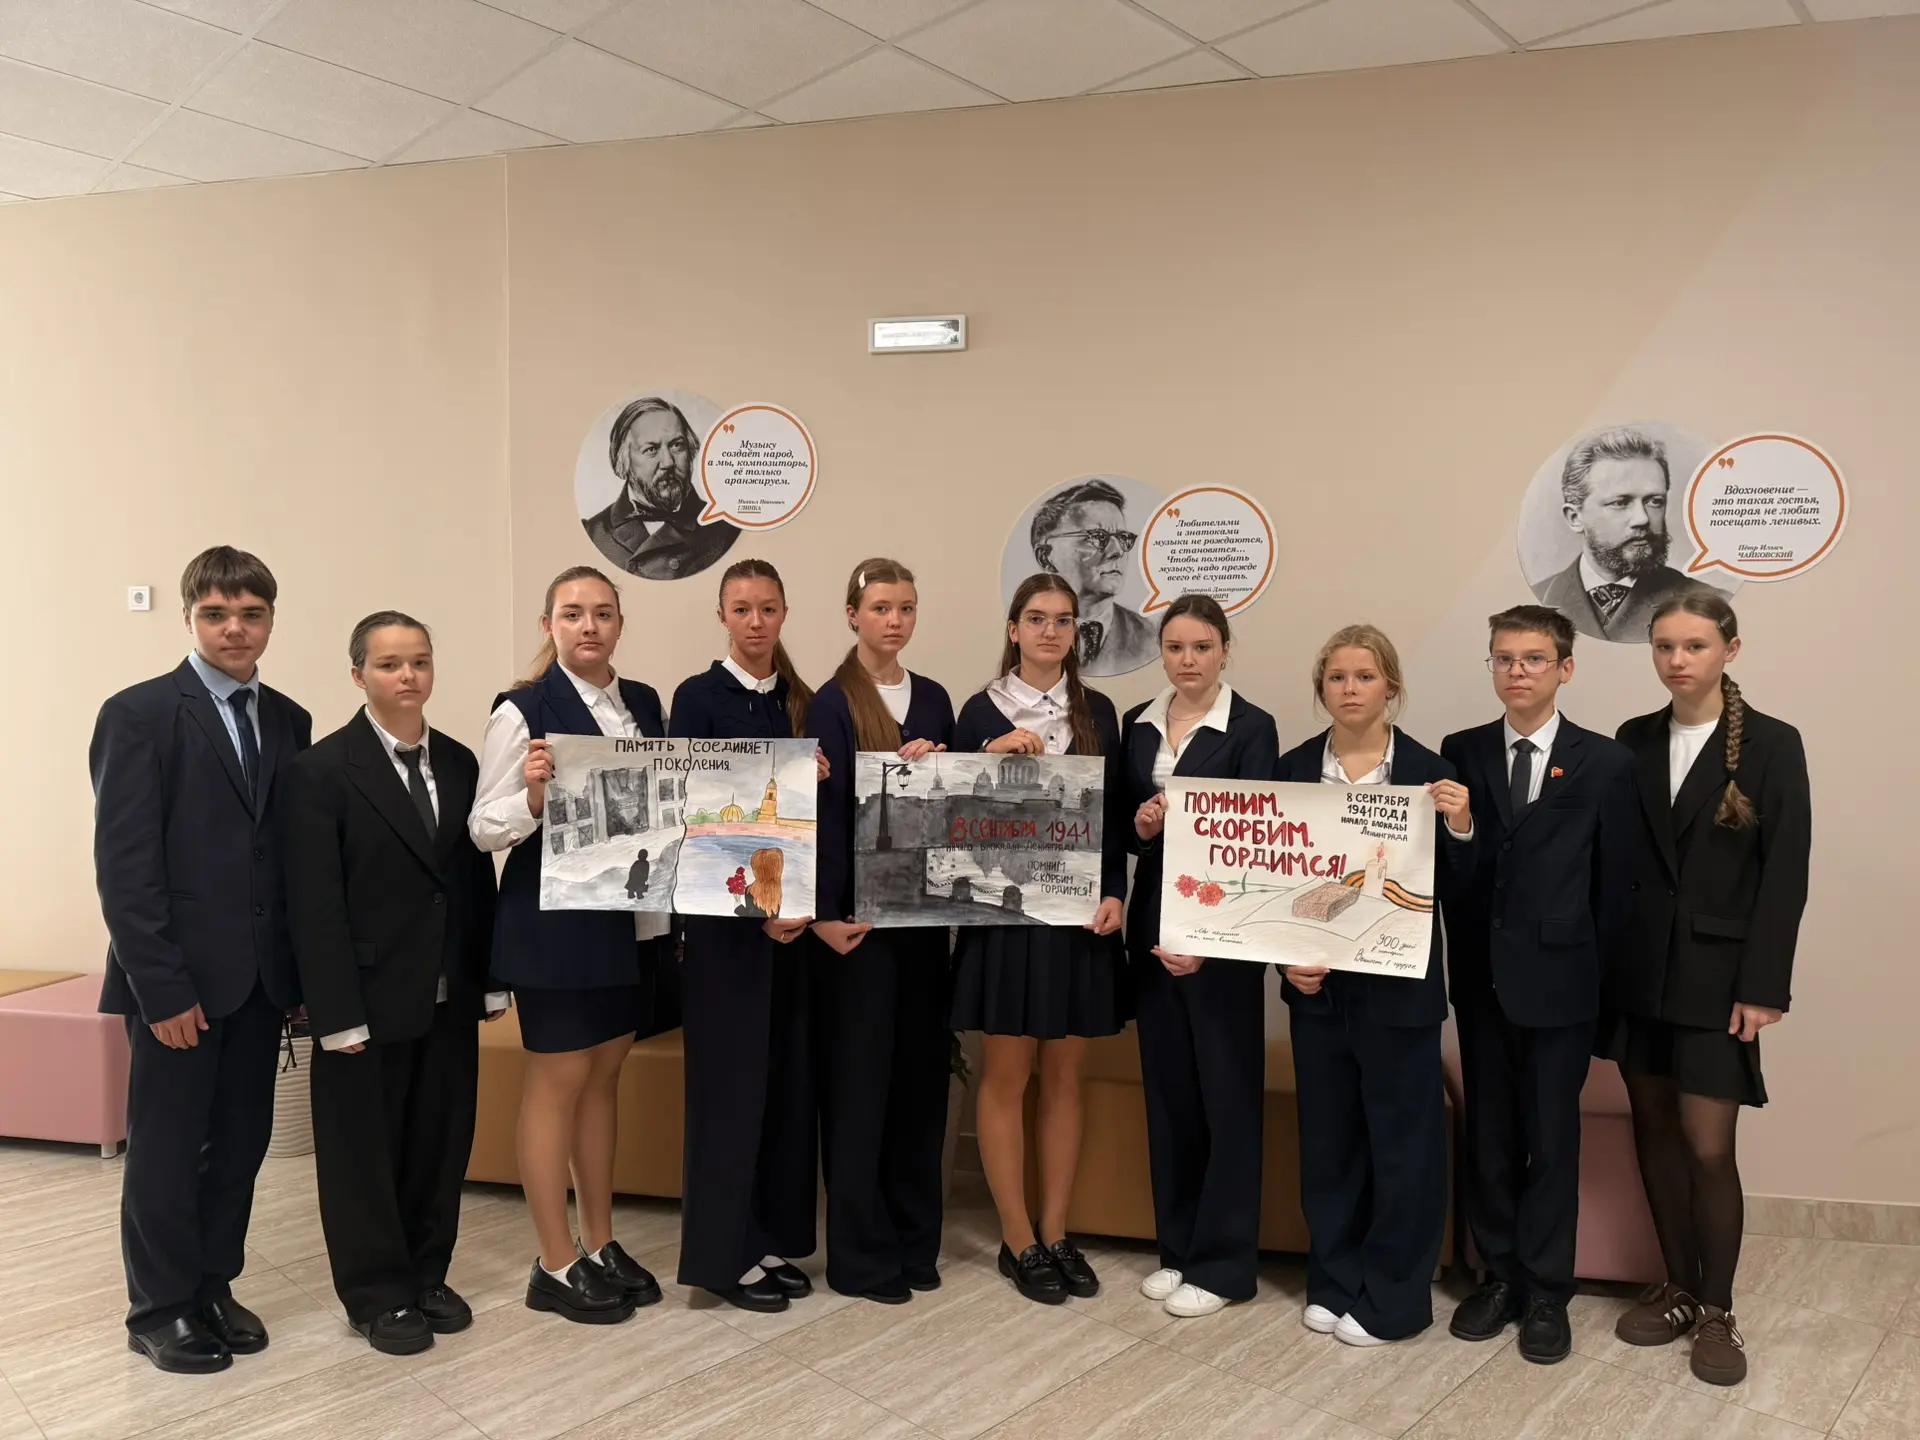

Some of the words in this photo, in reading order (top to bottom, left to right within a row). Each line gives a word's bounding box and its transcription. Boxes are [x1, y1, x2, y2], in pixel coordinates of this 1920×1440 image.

[740, 440, 776, 450] Музыку
[722, 449, 760, 458] создаёт
[763, 449, 794, 459] народ,
[737, 460, 808, 468] композиторы,
[733, 468, 742, 476] её
[724, 478, 790, 486] аранжируем.
[1724, 484, 1794, 496] Вдохновение
[1736, 497, 1774, 505] такая
[1776, 496, 1820, 505] гостья,
[1712, 508, 1760, 517] которая
[1778, 505, 1820, 515] любит
[1176, 520, 1240, 528] Любителями
[1710, 518, 1766, 528] посещать
[1769, 516, 1821, 526] ленивых.
[1204, 536, 1264, 546] рождаются,
[1166, 555, 1198, 564] Чтобы
[1200, 554, 1250, 563] полюбить
[1158, 566, 1195, 574] музыку,
[1222, 564, 1258, 572] прежде
[1192, 572, 1201, 580] её
[1203, 574, 1248, 582] слушать.
[615, 740, 675, 752] ПАМЯТЬ
[692, 741, 774, 754] СОЕДИНЯЕТ
[1184, 791, 1284, 818] ПОМНИМ.
[1346, 792, 1352, 802] 8
[1356, 793, 1410, 807] СЕНТЯБРЯ
[1347, 804, 1372, 818] 1941
[1374, 806, 1408, 822] ГОДА
[1341, 816, 1368, 826] НАЧАЛО
[1372, 820, 1407, 832] БЛОКАДЫ
[950, 816, 968, 844] 8
[969, 818, 1038, 840] СЕНТЯБРЯ
[1046, 820, 1090, 846] 1941
[1194, 816, 1314, 848] СКОРБИМ.
[1027, 860, 1066, 873] ПОМНИМ
[1209, 844, 1347, 880] ГОРДИМСЯ!
[1033, 872, 1074, 884] СКОРБИМ
[1041, 882, 1092, 897] ГОРДИМСЯ!
[1376, 934, 1400, 950] 900
